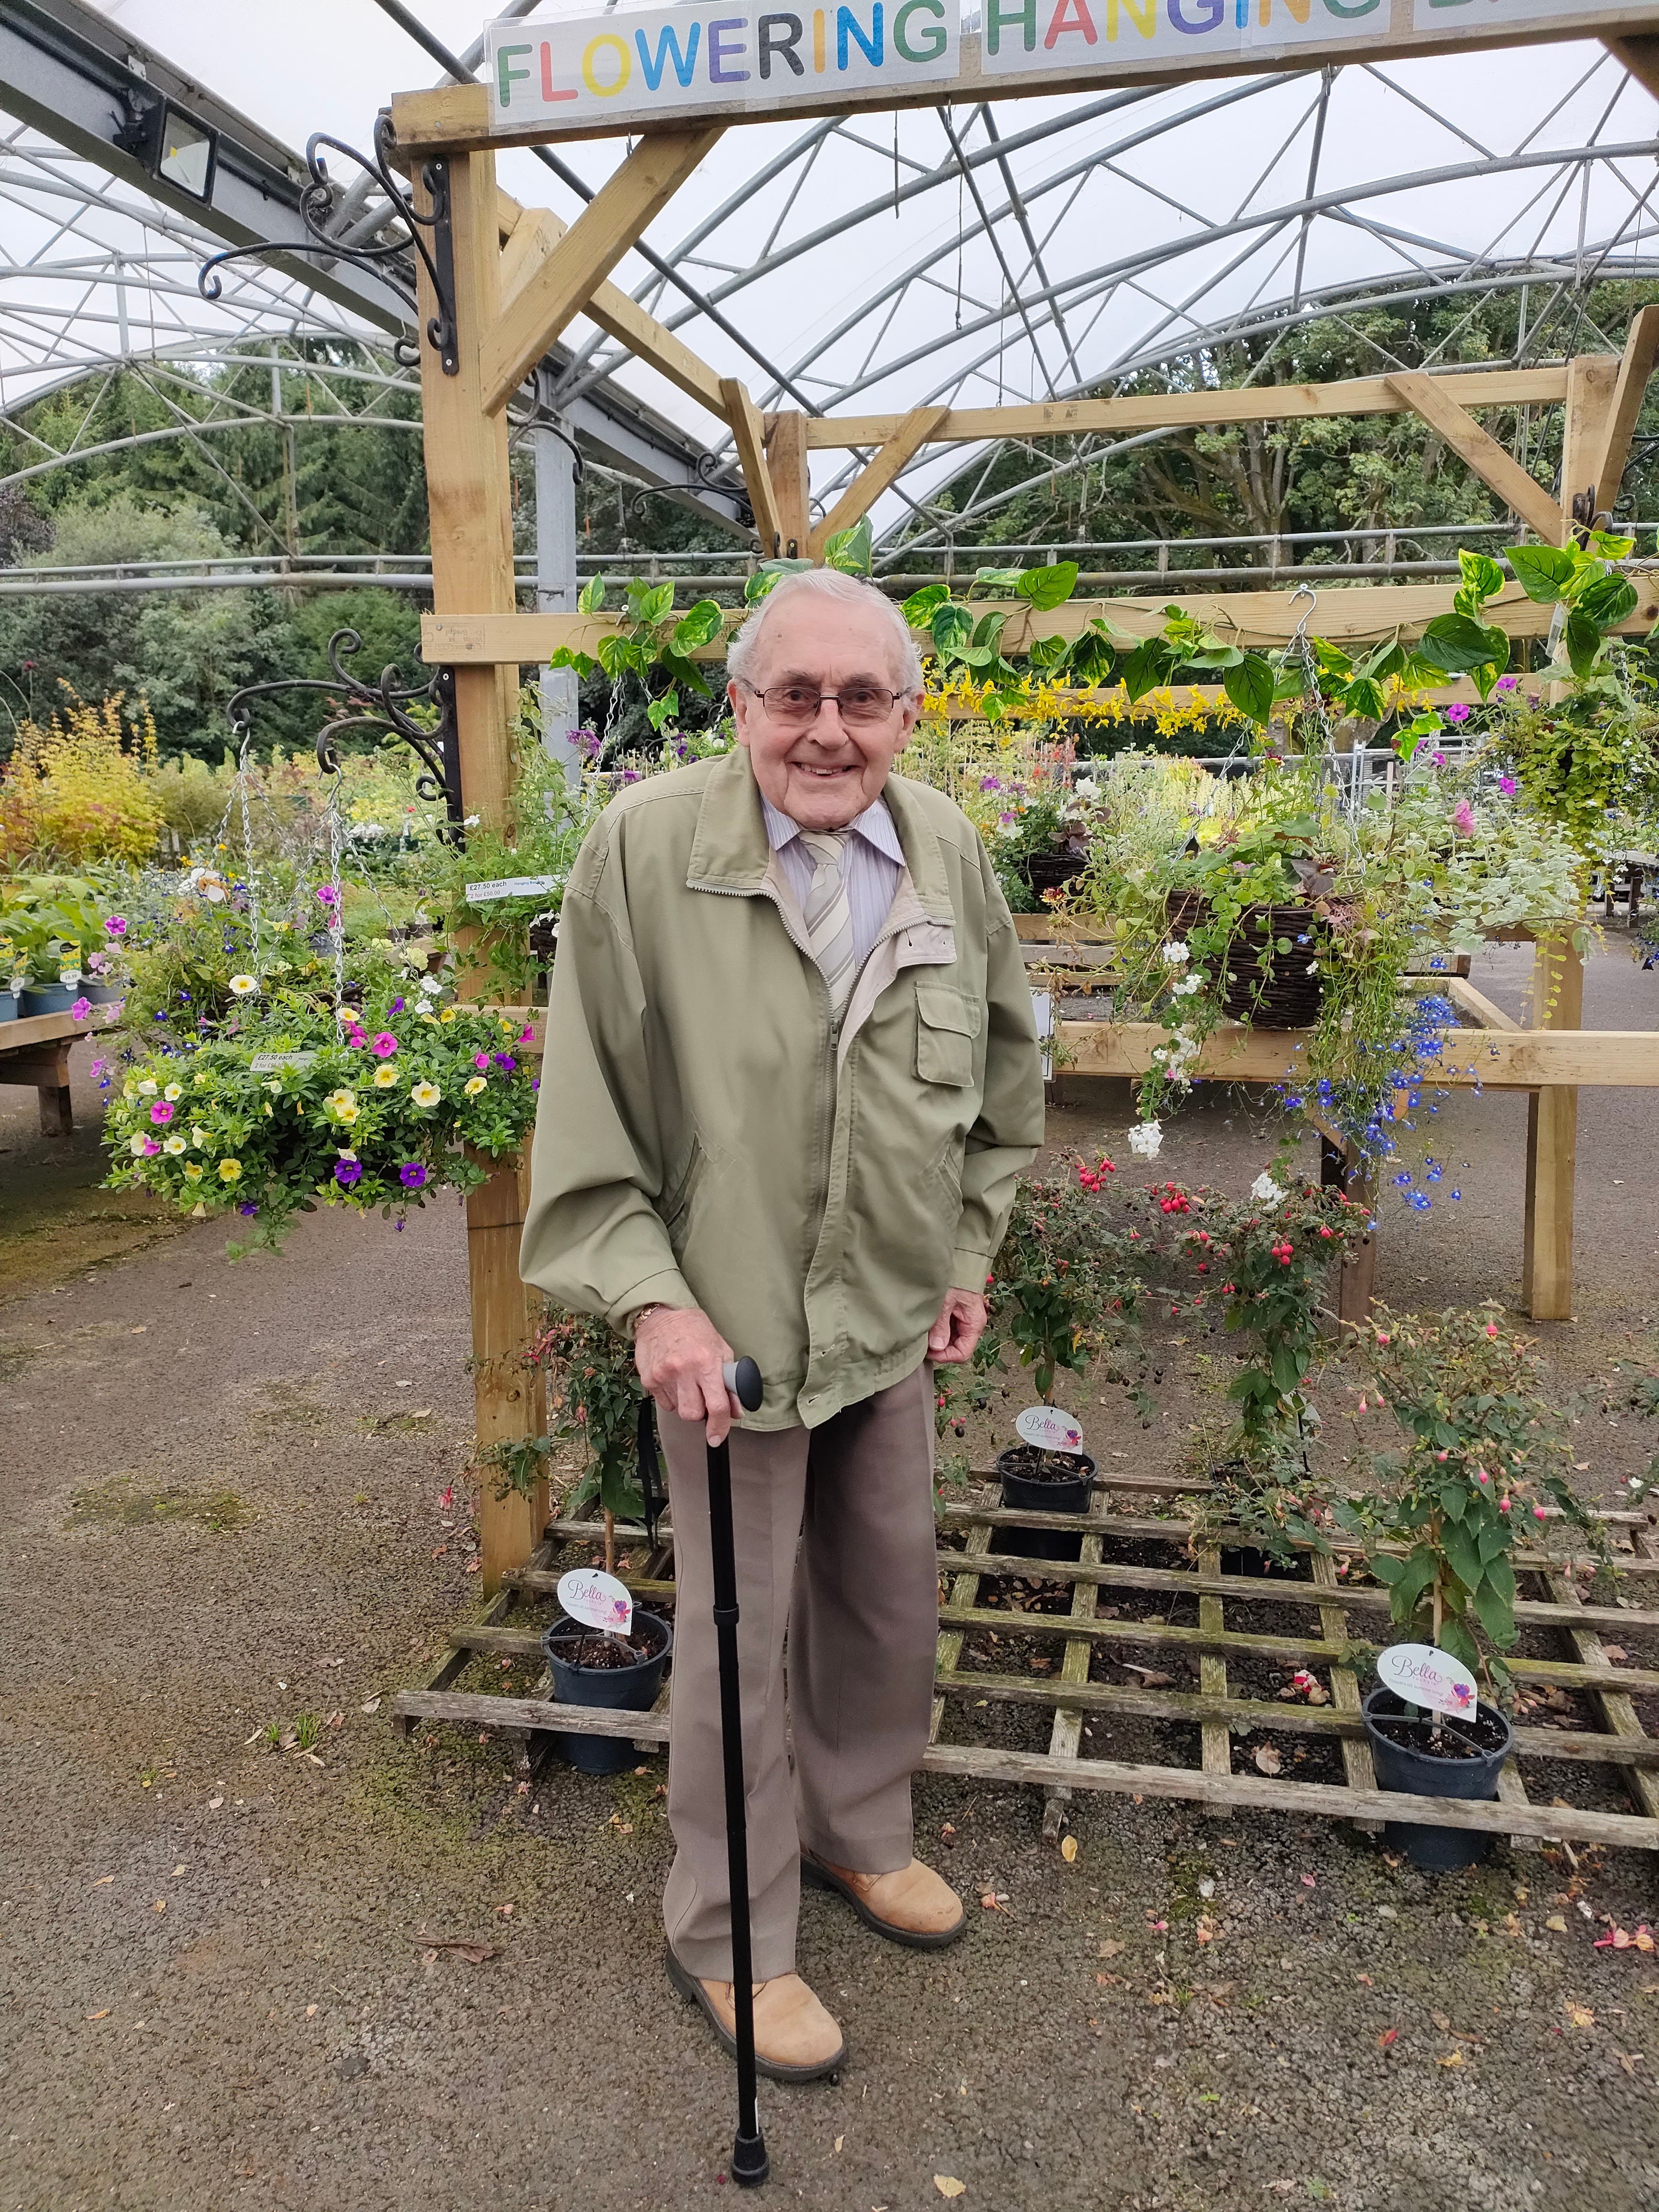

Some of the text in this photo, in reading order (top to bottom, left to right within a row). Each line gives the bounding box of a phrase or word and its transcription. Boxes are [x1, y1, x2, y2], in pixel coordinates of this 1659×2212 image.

[497, 0, 1382, 108] FLOWERING HANG
[469, 883, 490, 891] £27.50
[1025, 1415, 1059, 1431] Bella
[568, 1580, 606, 1602] Bella
[1392, 1655, 1442, 1683] Bella
[1389, 1678, 1406, 1686] Flowers
